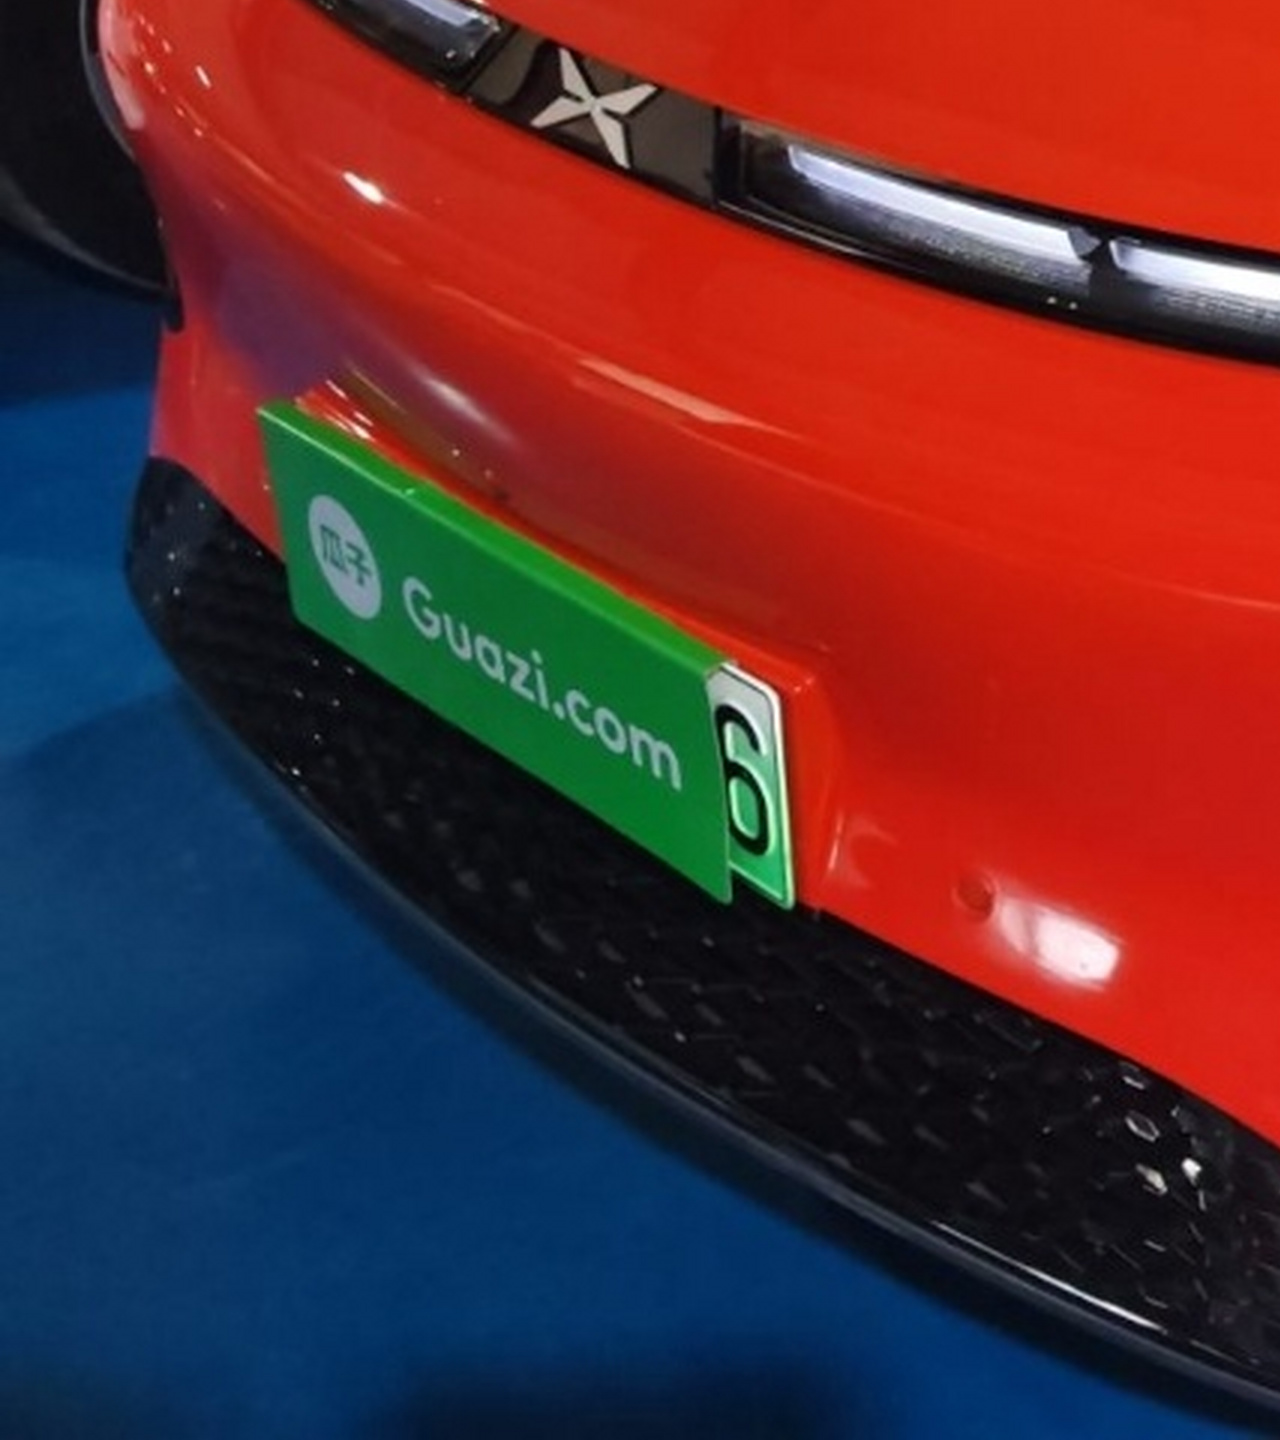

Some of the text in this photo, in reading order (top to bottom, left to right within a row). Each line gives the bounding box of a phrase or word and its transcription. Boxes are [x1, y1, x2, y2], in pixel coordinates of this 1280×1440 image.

[319, 523, 373, 588] 瓜子
[402, 576, 682, 791] Guazi.com
[714, 702, 774, 858] 6
